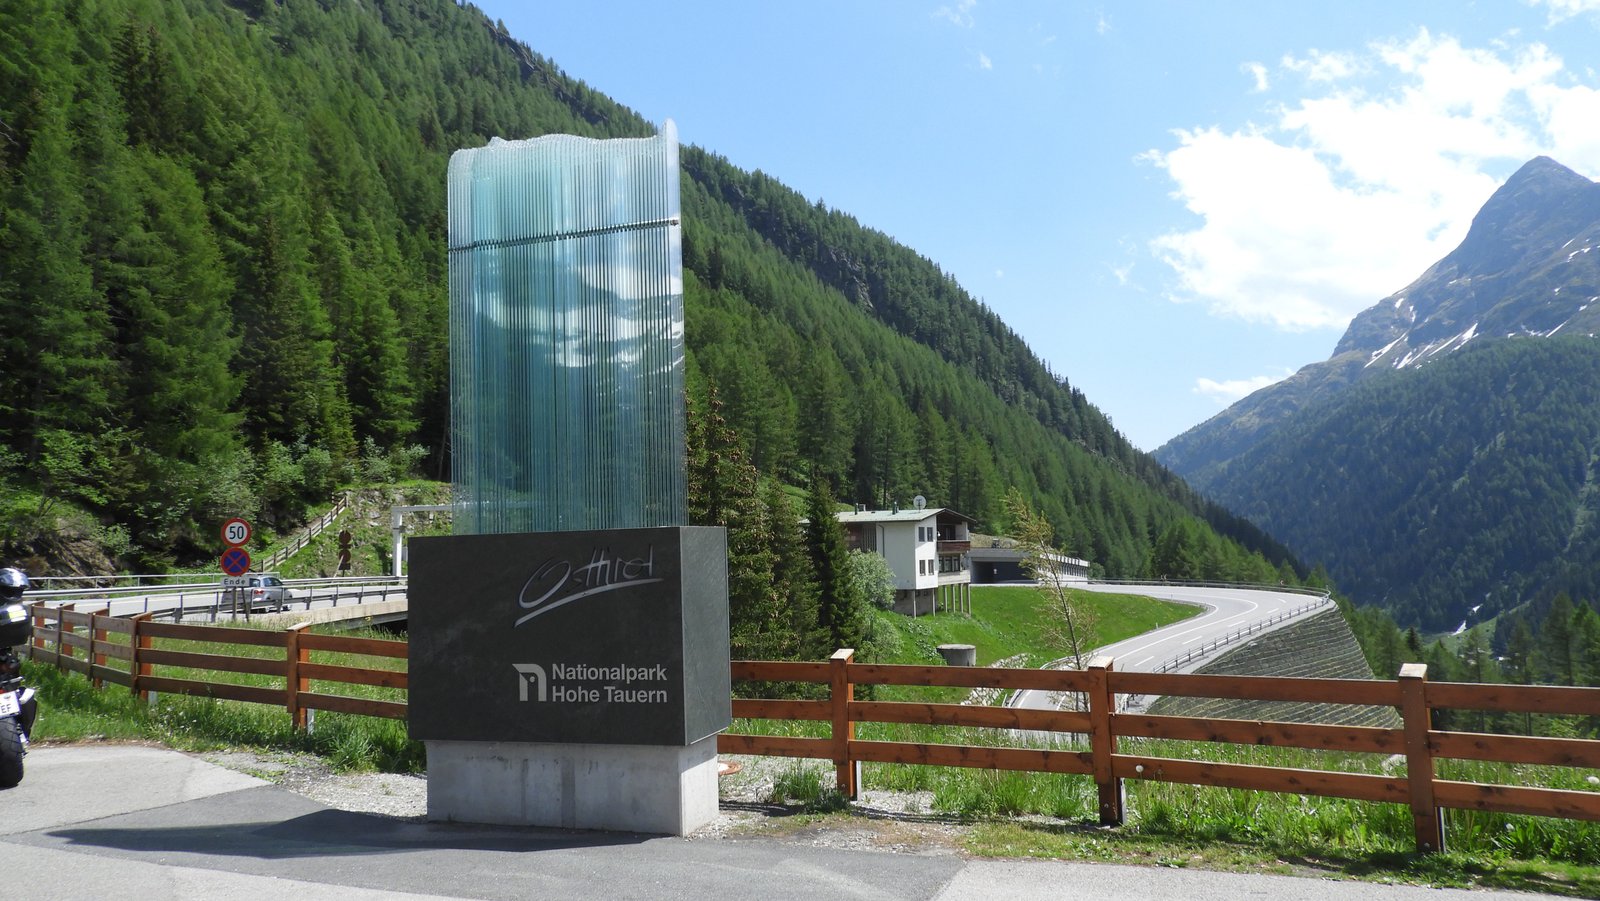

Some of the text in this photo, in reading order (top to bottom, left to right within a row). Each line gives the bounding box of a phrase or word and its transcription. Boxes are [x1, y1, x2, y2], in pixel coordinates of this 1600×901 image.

[229, 526, 244, 539] 50
[552, 663, 668, 684] Nationalpark
[552, 685, 668, 703] Hohe Tauern
